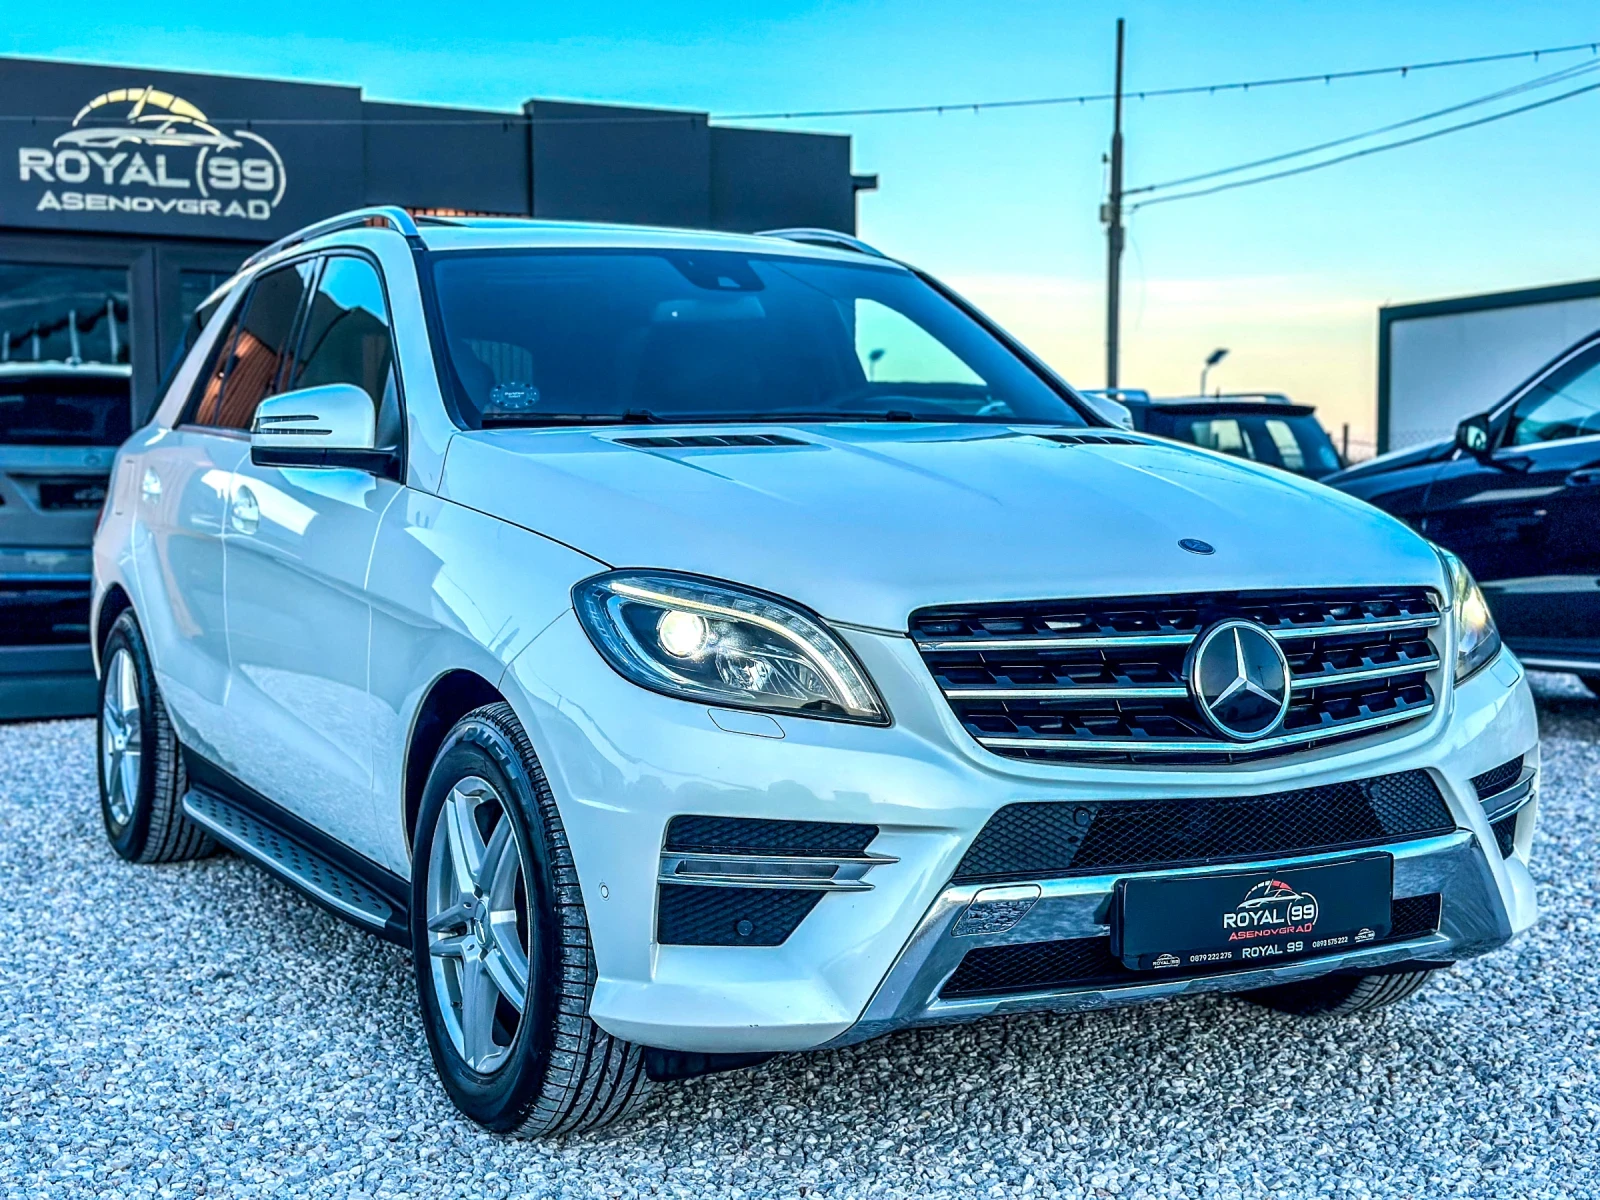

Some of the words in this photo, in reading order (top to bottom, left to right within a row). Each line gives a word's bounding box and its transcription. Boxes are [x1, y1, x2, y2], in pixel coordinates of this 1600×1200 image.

[19, 148, 190, 188] ROYAL
[37, 190, 271, 220] ASENOVGRAD
[1223, 908, 1285, 929] ROYAL
[1228, 922, 1313, 942] ASENOVGRAD
[1242, 944, 1283, 959] ROYAL
[1286, 941, 1304, 953] 99
